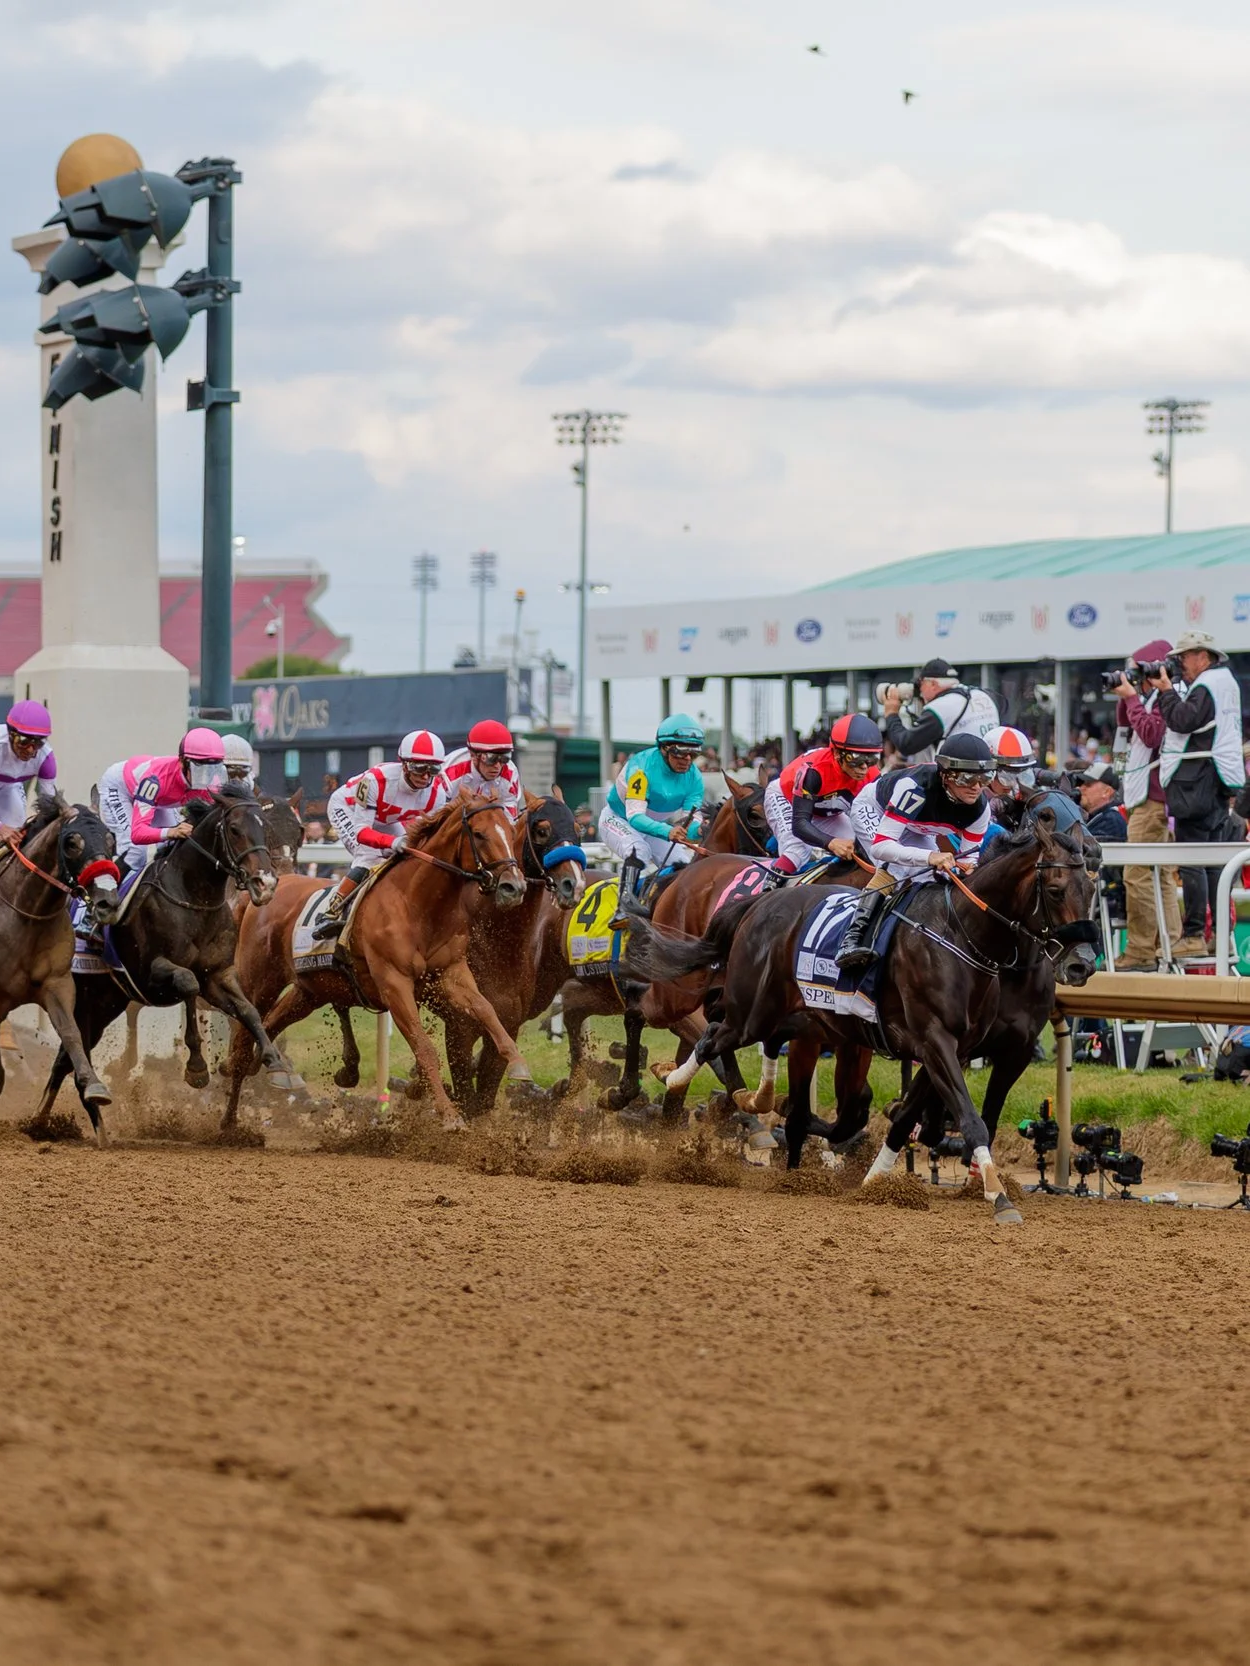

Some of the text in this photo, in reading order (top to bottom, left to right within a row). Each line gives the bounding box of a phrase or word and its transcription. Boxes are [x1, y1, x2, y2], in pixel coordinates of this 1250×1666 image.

[50, 353, 62, 563] FNISH
[139, 780, 159, 801] 10
[356, 781, 368, 802] 15
[631, 778, 642, 795] 4
[898, 790, 926, 815] 17
[577, 882, 608, 932] 4
